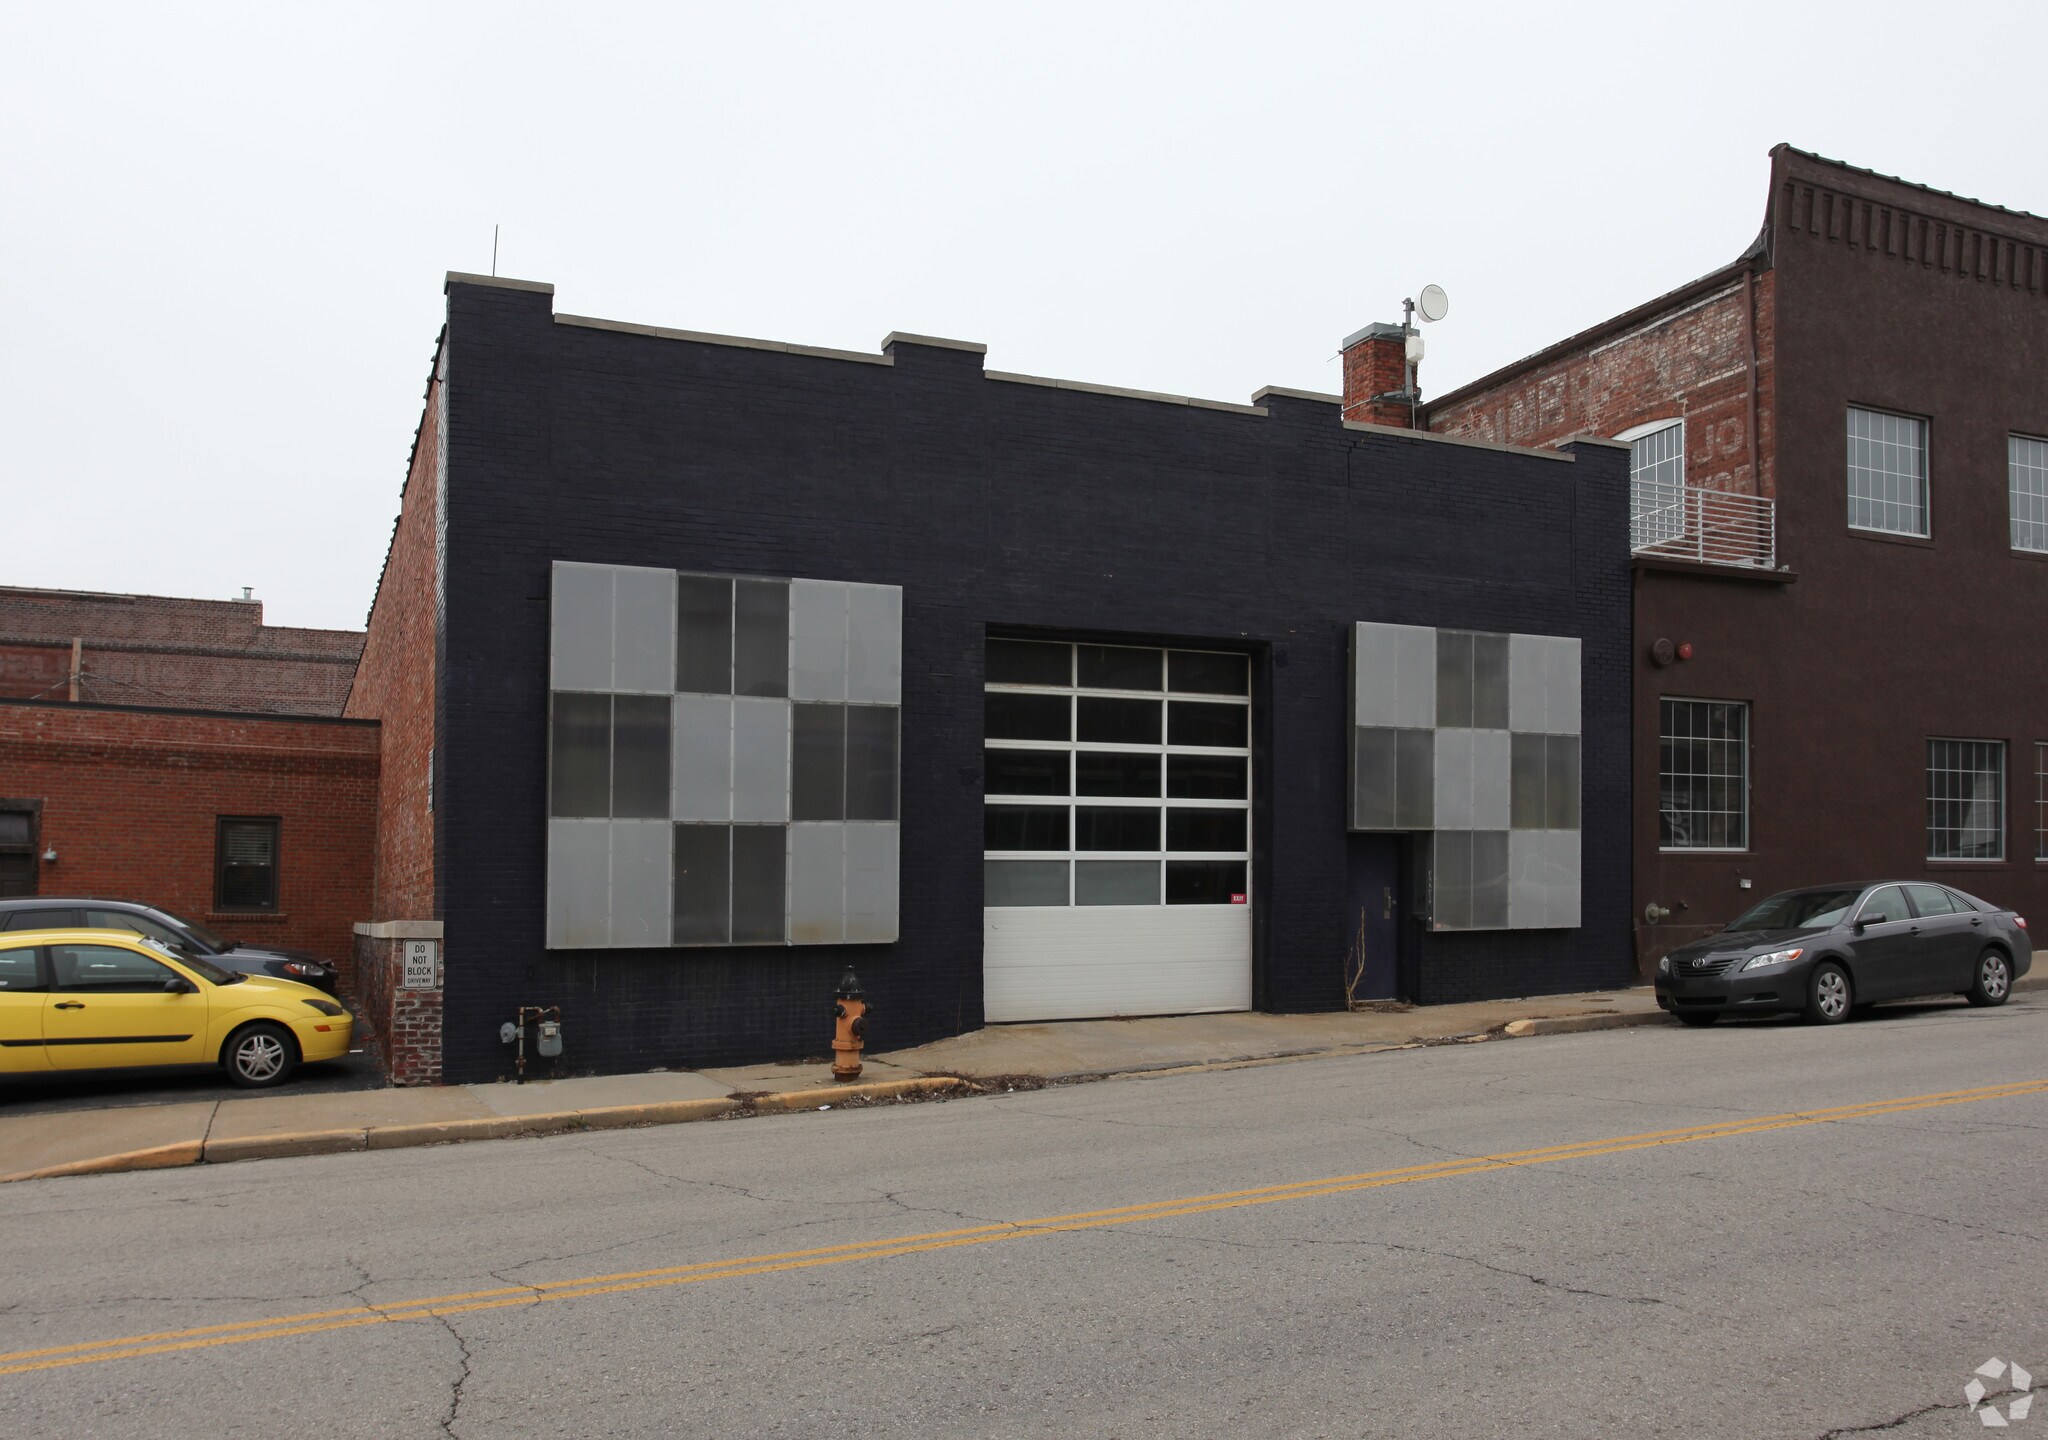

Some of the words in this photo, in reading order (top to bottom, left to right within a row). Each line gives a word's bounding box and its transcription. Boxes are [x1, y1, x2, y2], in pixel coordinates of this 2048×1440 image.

[415, 945, 426, 954] DO
[412, 956, 427, 965] NOT
[407, 967, 432, 976] BLOCK
